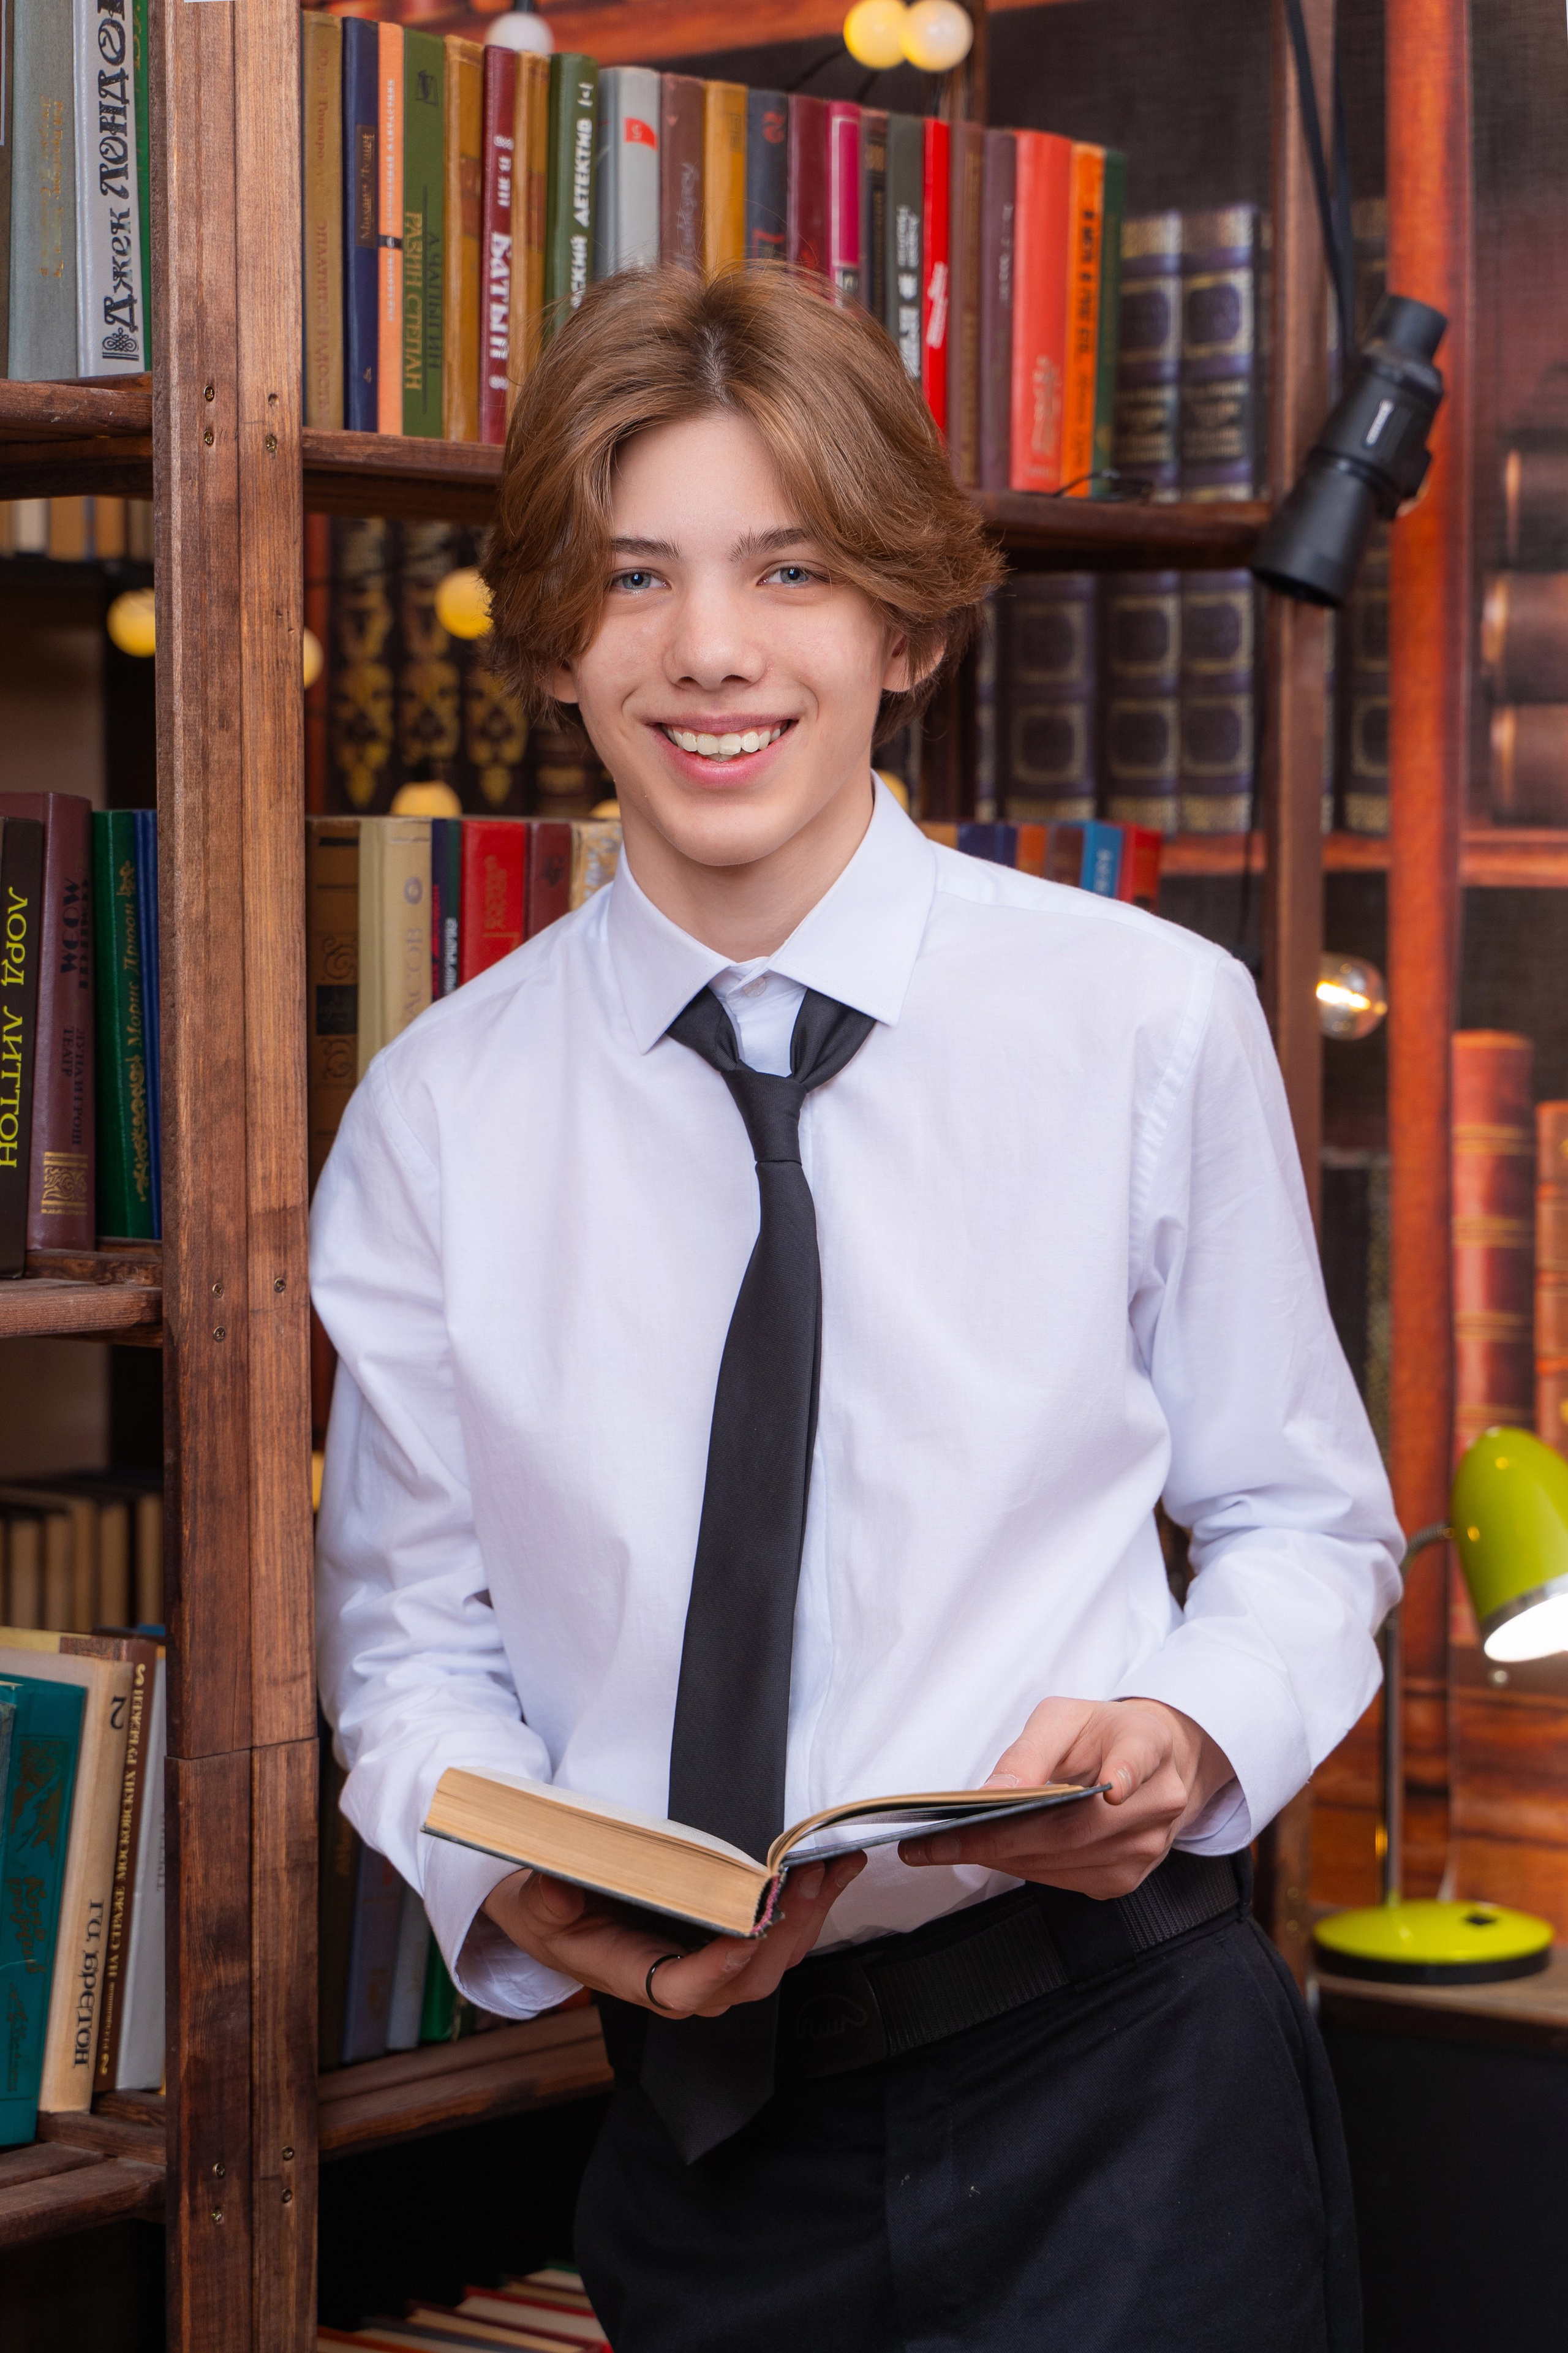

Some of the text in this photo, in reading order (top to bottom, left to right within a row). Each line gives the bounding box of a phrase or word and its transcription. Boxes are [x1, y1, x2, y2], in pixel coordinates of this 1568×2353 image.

[315, 100, 330, 160] Гончаро
[103, 208, 139, 333] Джек
[570, 117, 593, 310] СКИЙ ДЕТЕКТИВ
[404, 211, 423, 391] РАЗИН СТЕПАН
[488, 231, 513, 360] БАТЫЙ
[1, 886, 28, 987] ЛОРД
[60, 877, 80, 975] МОЭМ
[123, 902, 143, 1048] Морис Дрюон
[0, 1005, 23, 1169] ЛИТТОН
[62, 1026, 75, 1077] ТЕАТР
[72, 1094, 83, 1146] ГРОШ
[108, 1689, 146, 1978] НА СТРАЖЕ МОСКОВСКИХ РУБЕЖЕЙ
